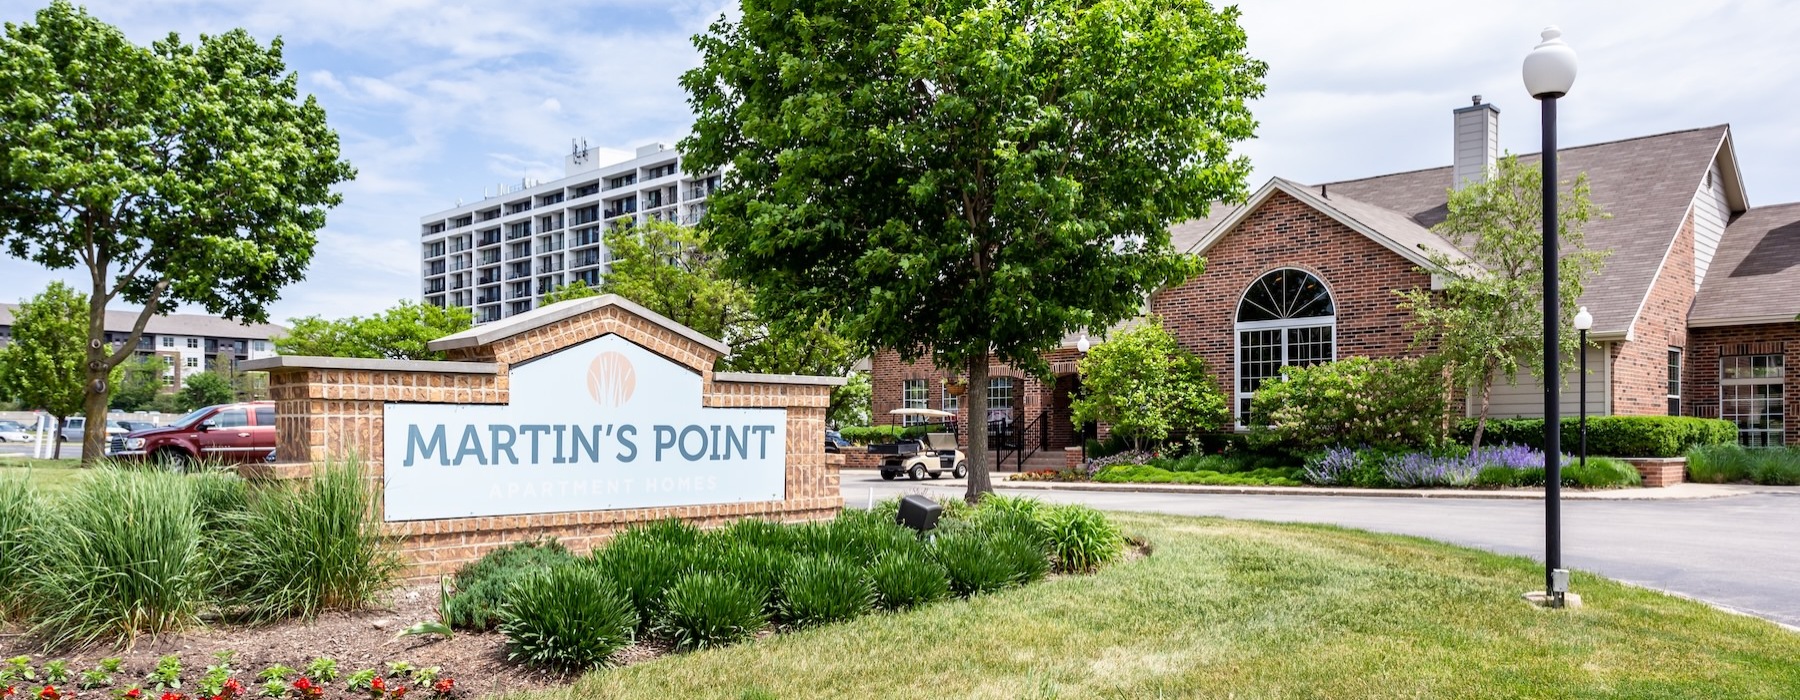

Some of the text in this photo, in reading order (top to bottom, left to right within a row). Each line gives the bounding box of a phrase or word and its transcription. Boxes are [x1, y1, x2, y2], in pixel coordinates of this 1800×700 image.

[402, 424, 776, 467] MARTIN'S POINT
[489, 475, 718, 500] APARTMENT HOMES
